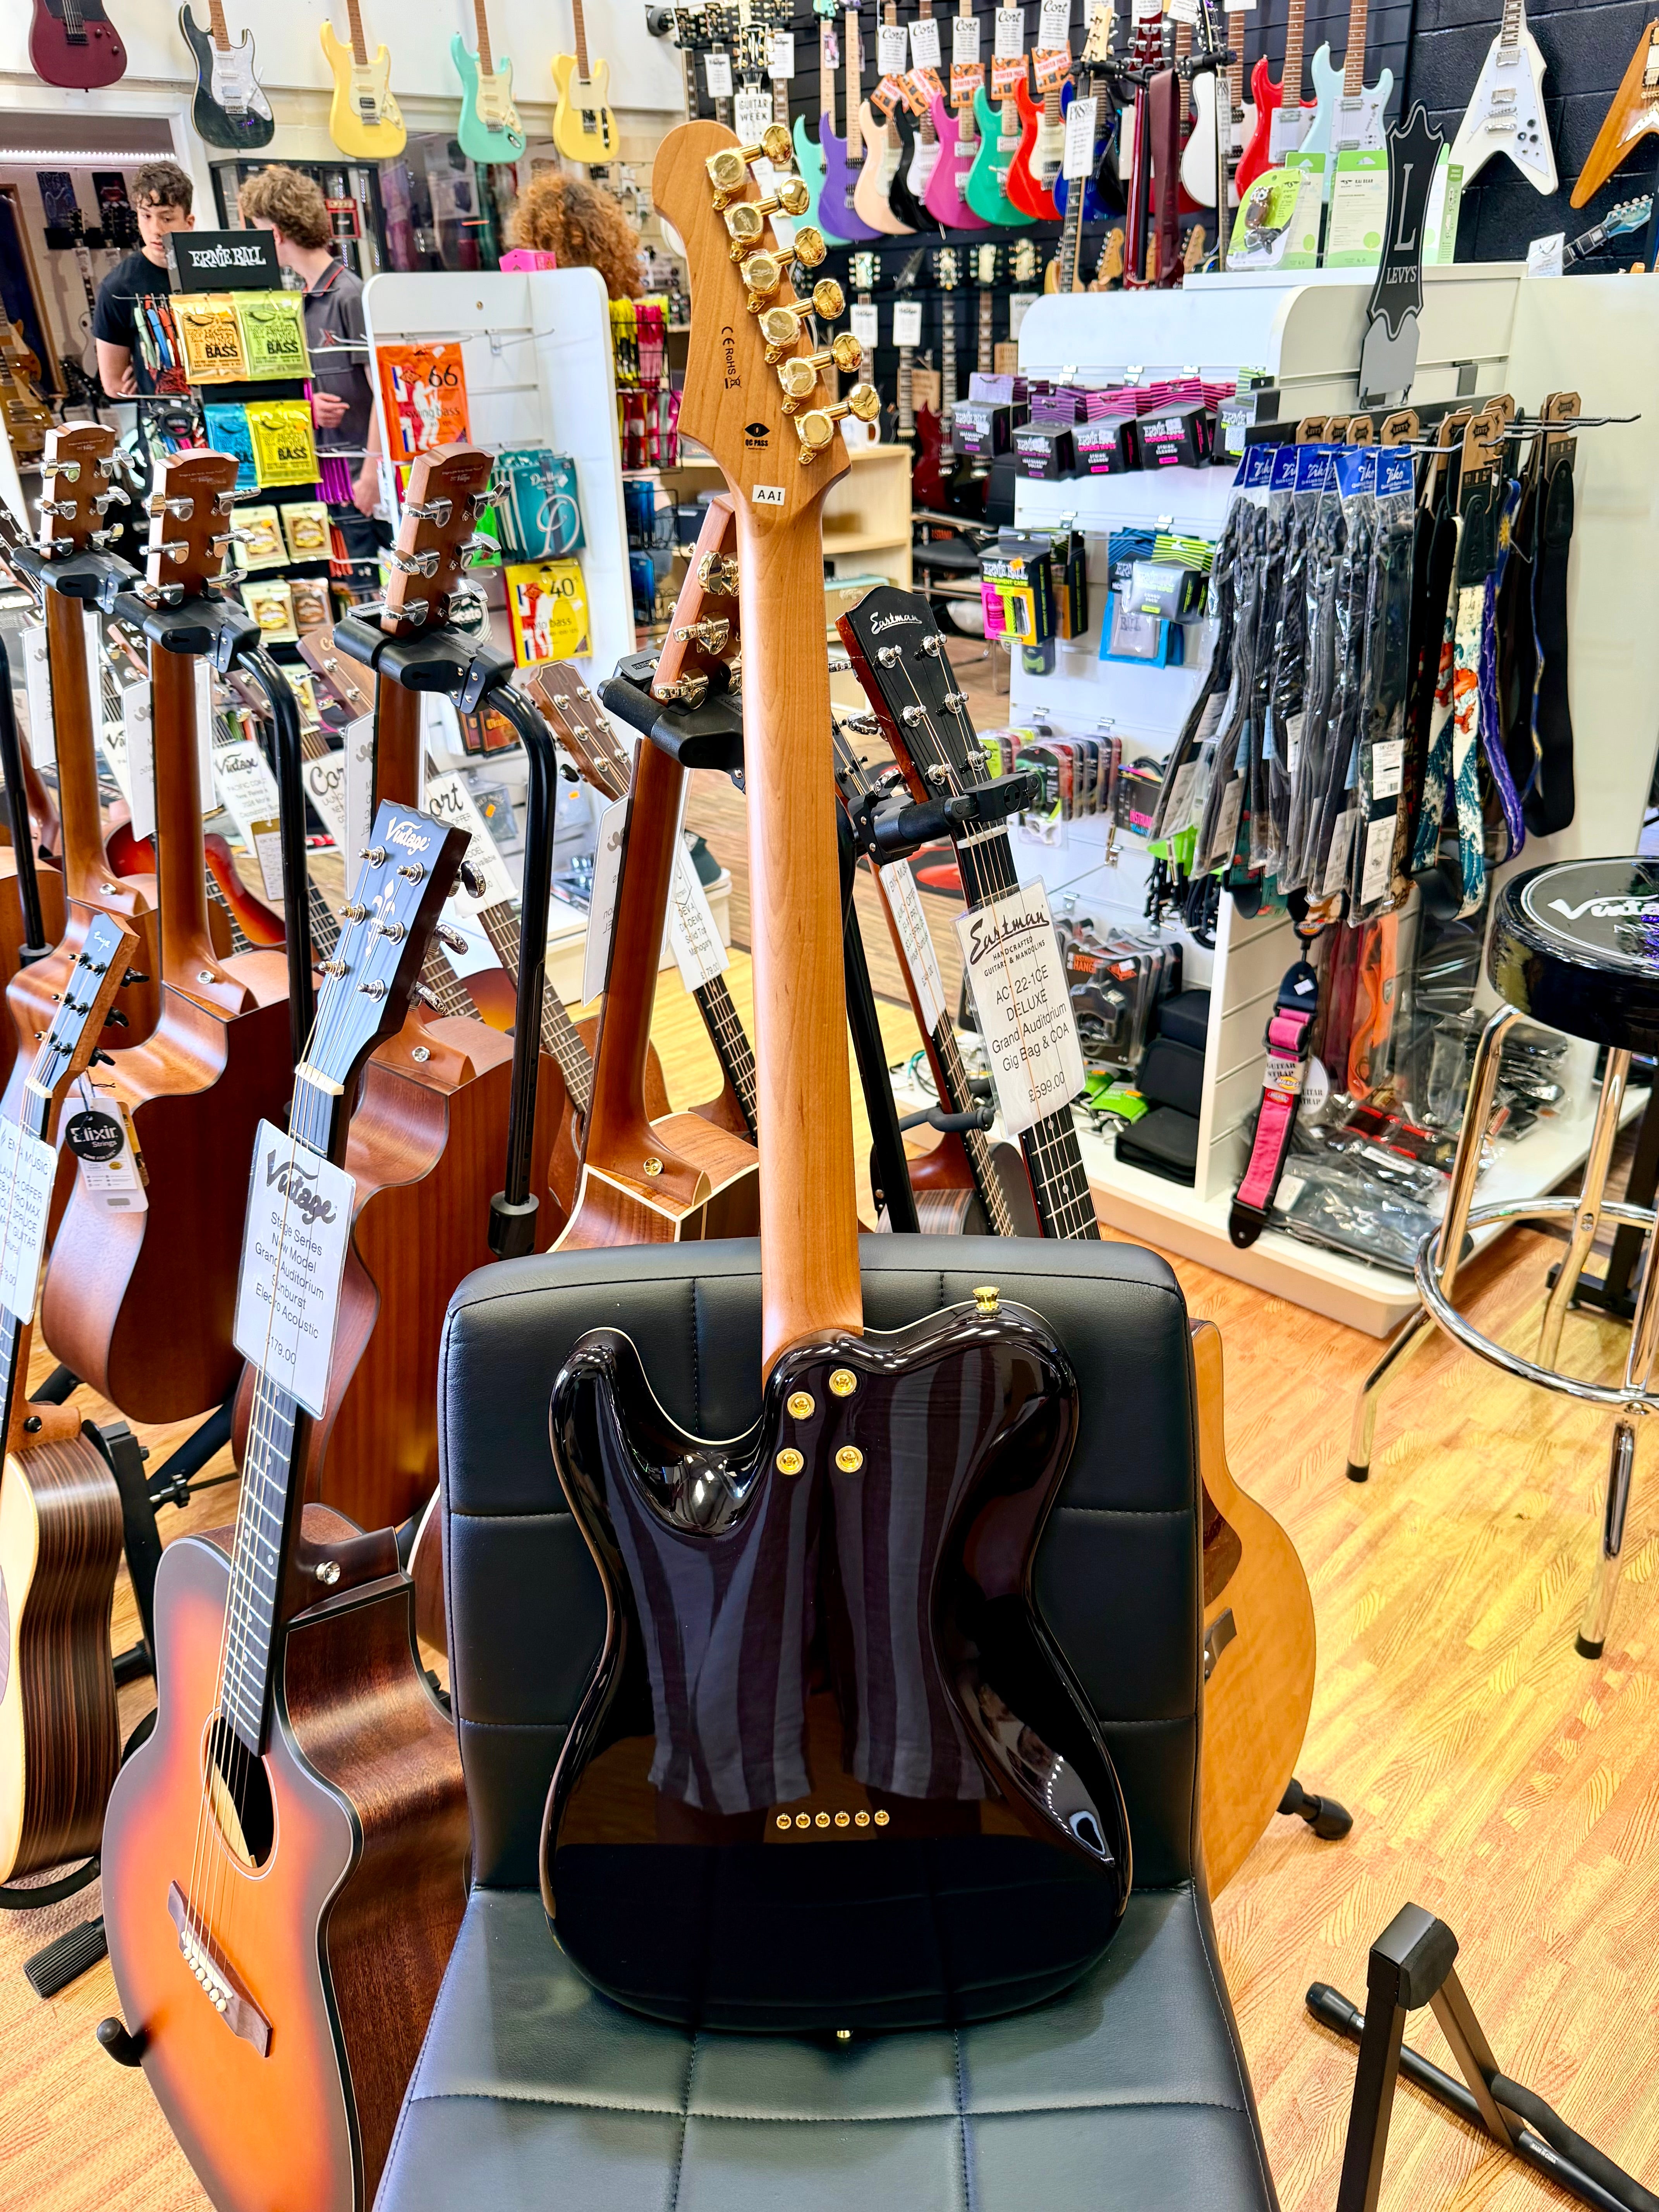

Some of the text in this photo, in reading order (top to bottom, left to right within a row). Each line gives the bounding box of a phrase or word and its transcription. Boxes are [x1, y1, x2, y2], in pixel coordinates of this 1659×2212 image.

[232, 246, 266, 266] BALL
[205, 344, 238, 358] BASS
[267, 342, 298, 354] BASS
[725, 348, 736, 375] RoHS
[429, 364, 458, 387] 66
[278, 447, 307, 460] BASS
[870, 611, 923, 635] Eastman
[320, 637, 335, 651] Co
[215, 752, 258, 776] Vintage
[310, 766, 344, 797] Cor
[429, 782, 464, 817] ort
[386, 816, 431, 856] Vintage
[970, 911, 1050, 965] Eastman
[993, 936, 1033, 961] HANDCRAFTED
[700, 962, 720, 980] £79.00
[984, 960, 1007, 977] GUITARS
[1015, 939, 1046, 961] MANDOLINS
[996, 964, 1049, 1005] AC22-1CE
[1006, 988, 1048, 1022] DELUXE
[992, 1003, 1067, 1054] Grand Auditorium
[1003, 1022, 1069, 1072] Gig Bag & COA
[1028, 1070, 1065, 1103] £599.00
[70, 1125, 118, 1143] Elixir
[8, 1138, 48, 1175] ENA MUSIC
[266, 1149, 336, 1225] Vintage
[271, 1211, 323, 1256] Stage Series
[272, 1233, 317, 1273] New Model
[271, 1274, 306, 1310] Sunburst
[280, 1261, 324, 1300] Auditorium
[256, 1282, 319, 1339] Elecro Acoustic
